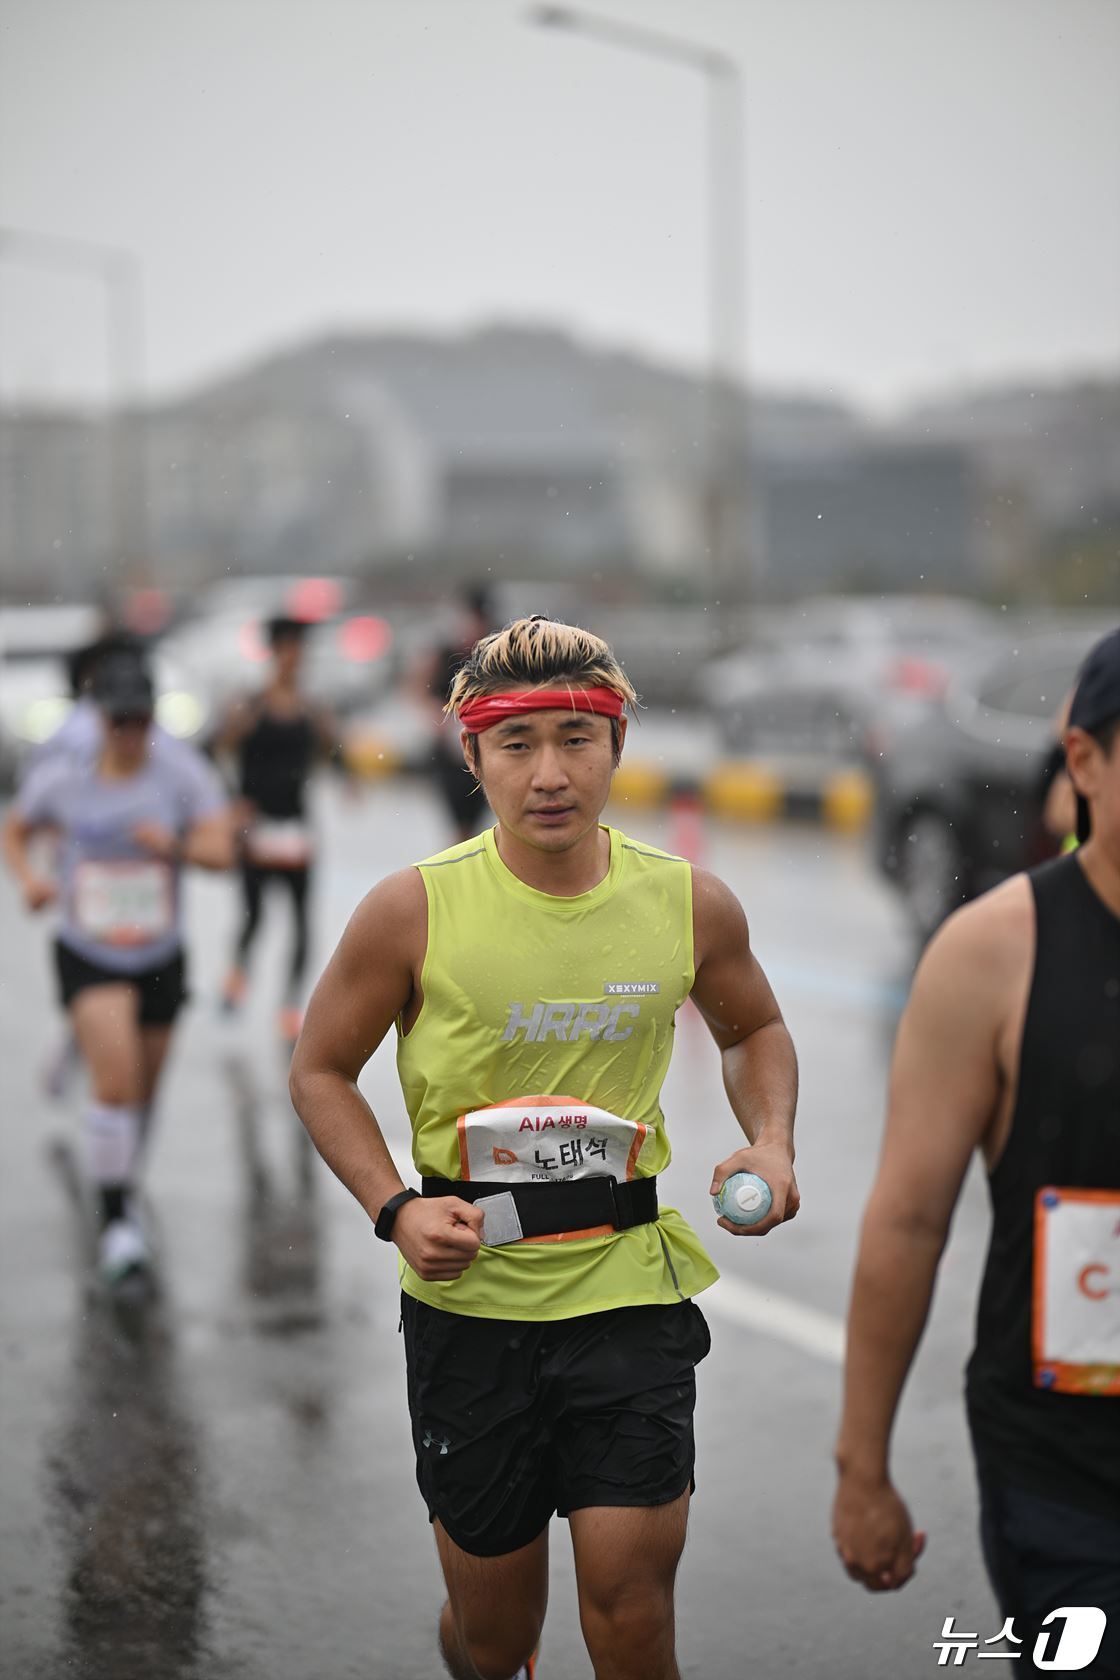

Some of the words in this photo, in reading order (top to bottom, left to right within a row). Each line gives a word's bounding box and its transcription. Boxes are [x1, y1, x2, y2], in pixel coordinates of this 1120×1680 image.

[608, 984, 657, 993] XEXYMIX
[500, 1002, 641, 1042] HRRC
[518, 1115, 588, 1132] AIA생명
[493, 1146, 518, 1165] D
[534, 1137, 608, 1171] 노태석
[531, 1173, 550, 1181] FULL
[1077, 1262, 1110, 1302] C
